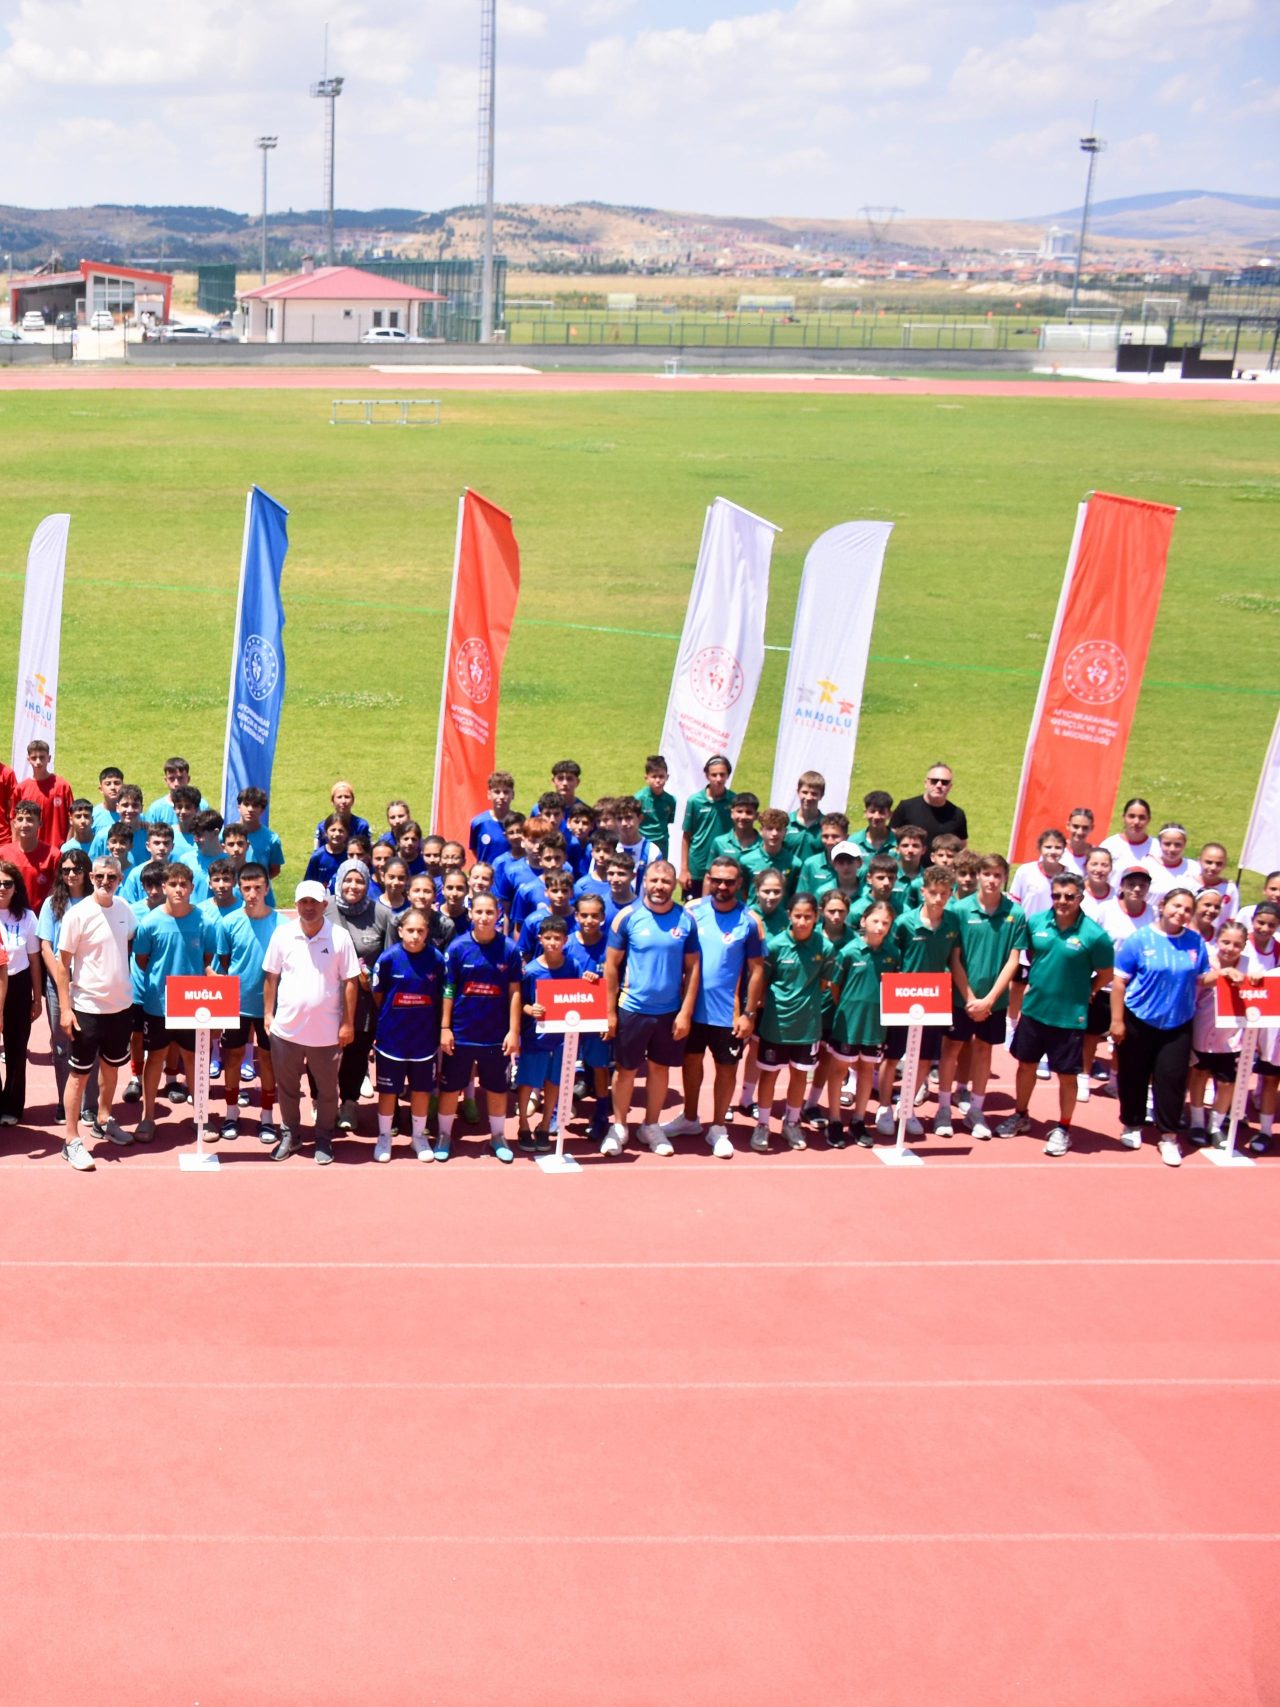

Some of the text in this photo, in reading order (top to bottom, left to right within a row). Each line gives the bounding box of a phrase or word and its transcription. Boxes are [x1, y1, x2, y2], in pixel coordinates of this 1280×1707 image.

[184, 989, 223, 1000] MUĞLA
[895, 986, 939, 997] KOCAELİ
[553, 992, 595, 1004] MANİSA
